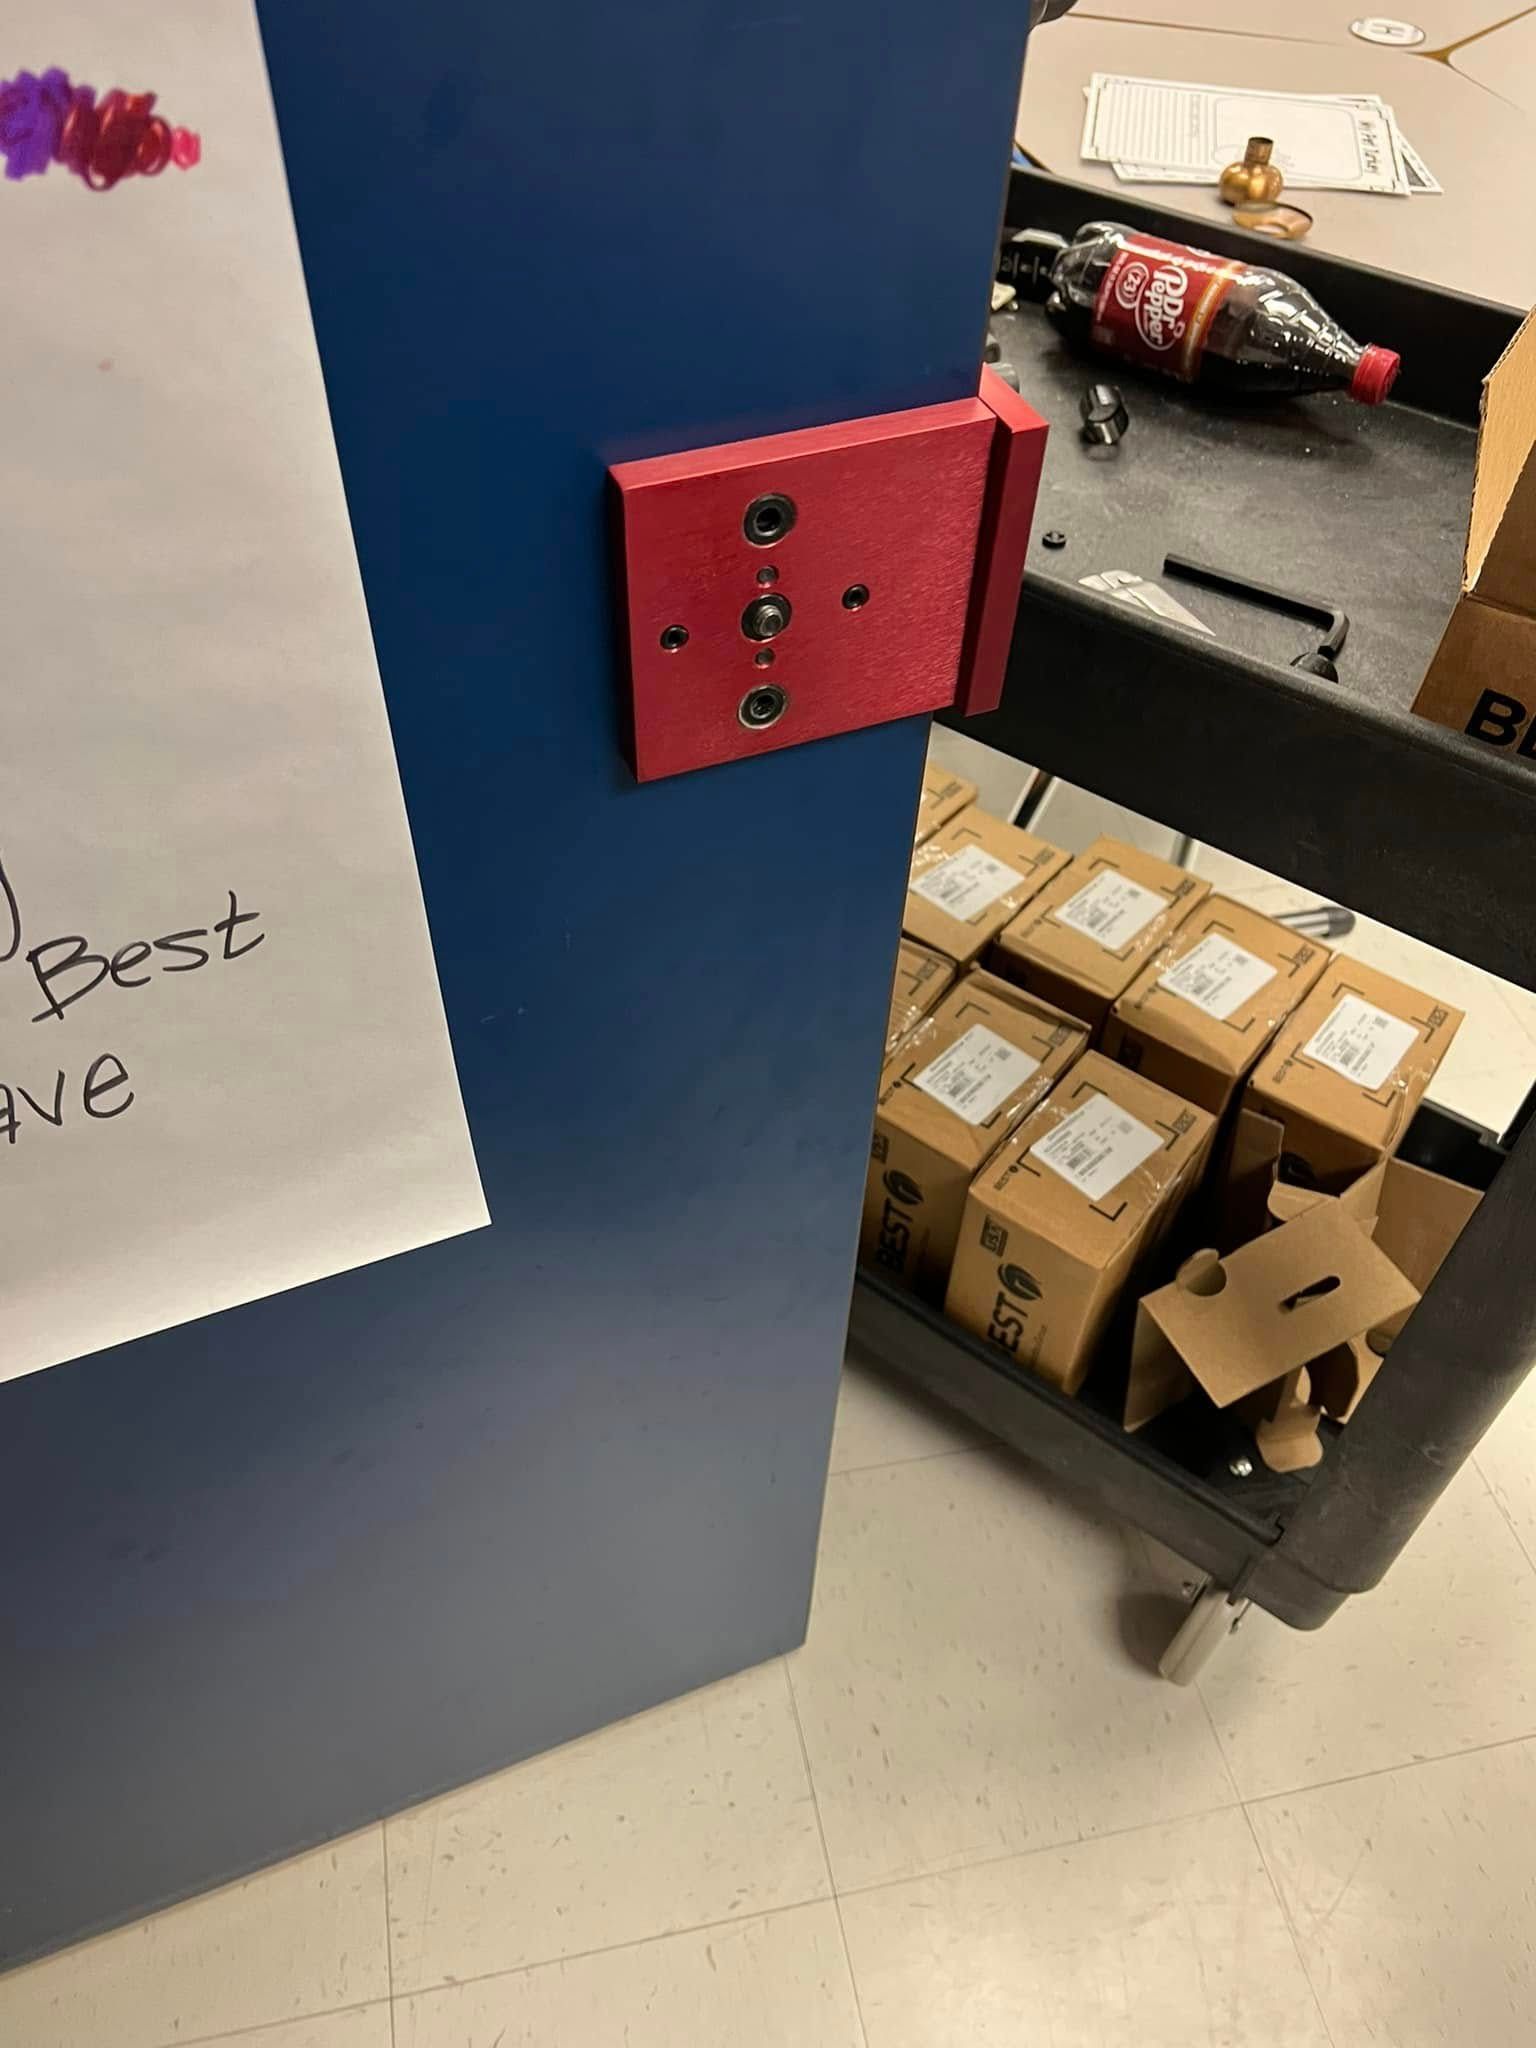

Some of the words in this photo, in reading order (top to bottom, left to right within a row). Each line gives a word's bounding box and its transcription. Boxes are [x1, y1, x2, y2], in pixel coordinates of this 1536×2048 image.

[1123, 271, 1142, 292] 23
[1144, 264, 1188, 346] Pepper
[1161, 293, 1185, 330] Dr
[26, 890, 265, 1022] Best
[987, 1291, 1029, 1353] EST
